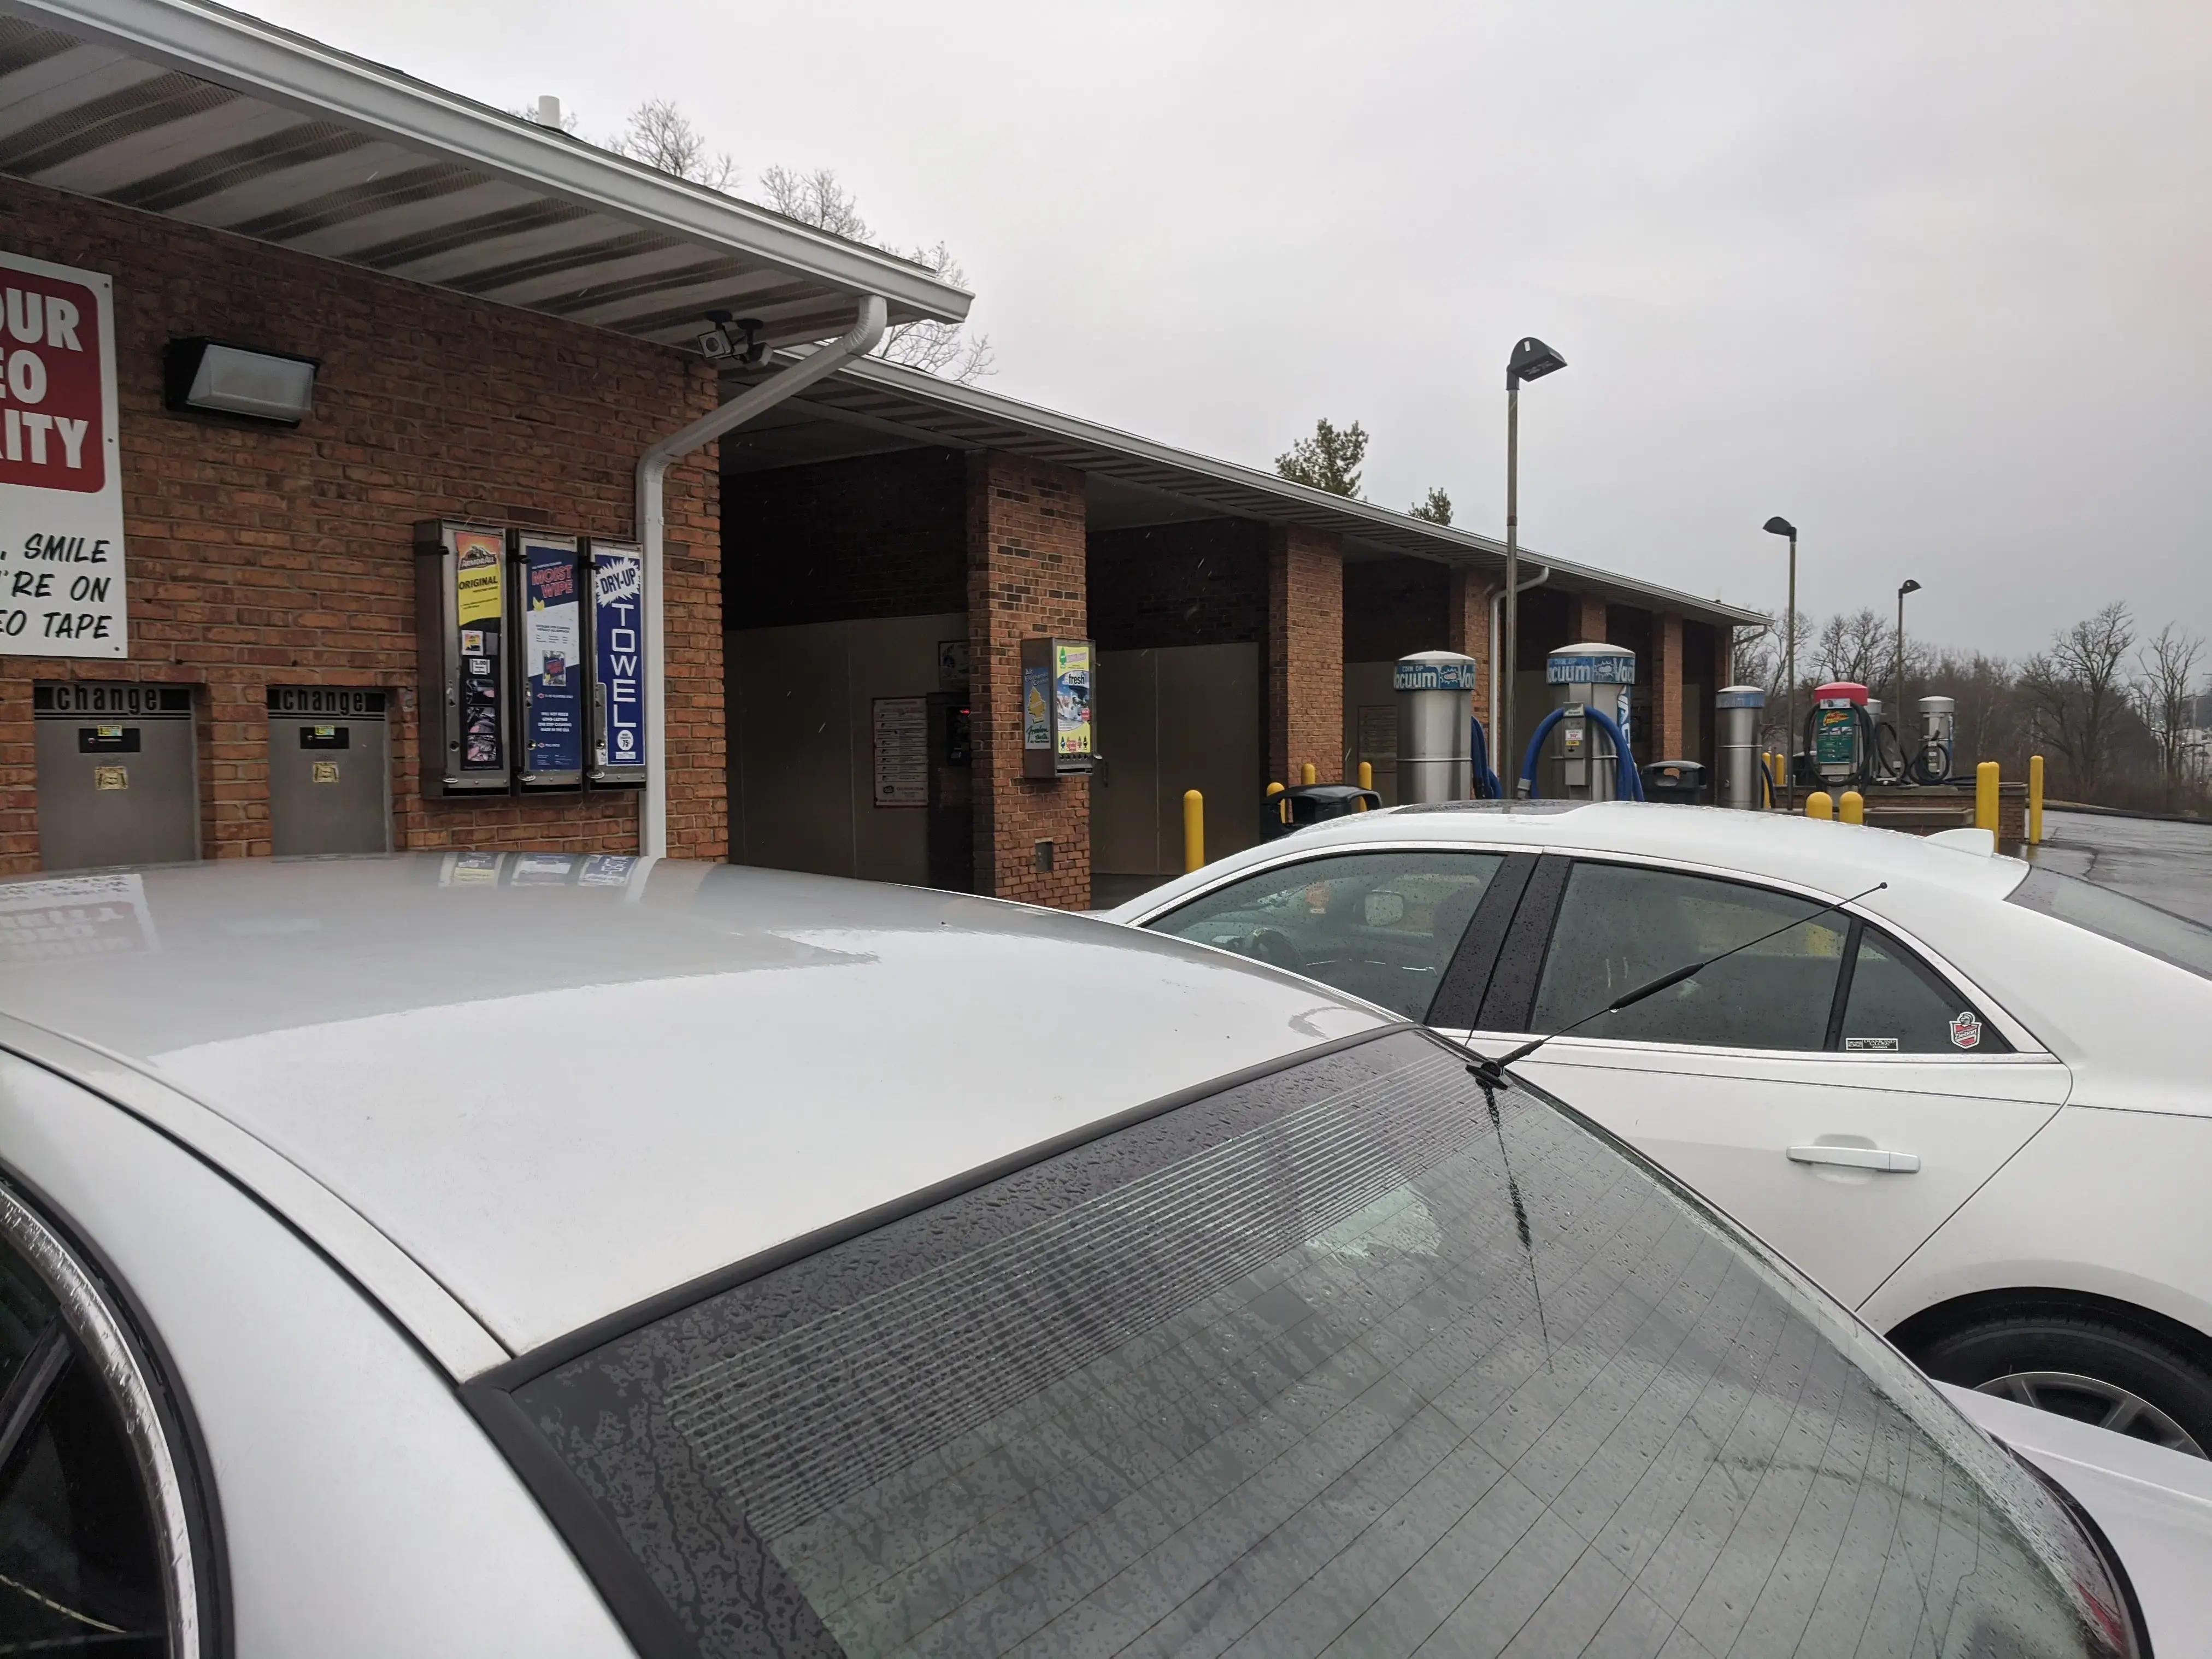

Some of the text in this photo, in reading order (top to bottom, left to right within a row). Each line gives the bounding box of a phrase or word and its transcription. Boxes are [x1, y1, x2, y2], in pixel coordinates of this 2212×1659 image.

[0, 287, 83, 351] UR
[0, 347, 47, 404] O
[0, 409, 89, 469] ITY
[24, 533, 110, 563] SMILE
[0, 570, 111, 603] 'RE ON
[459, 575, 498, 590] ORIGINAL
[531, 564, 573, 586] MOIST
[541, 579, 573, 598] WIPE
[599, 567, 636, 595] DRY-UP
[43, 612, 113, 639] TAPE
[610, 603, 637, 727] TOWEL
[1068, 673, 1085, 685] fresh
[57, 684, 157, 715] change
[283, 689, 363, 716] change
[1955, 1029, 1978, 1039] Ziebart
